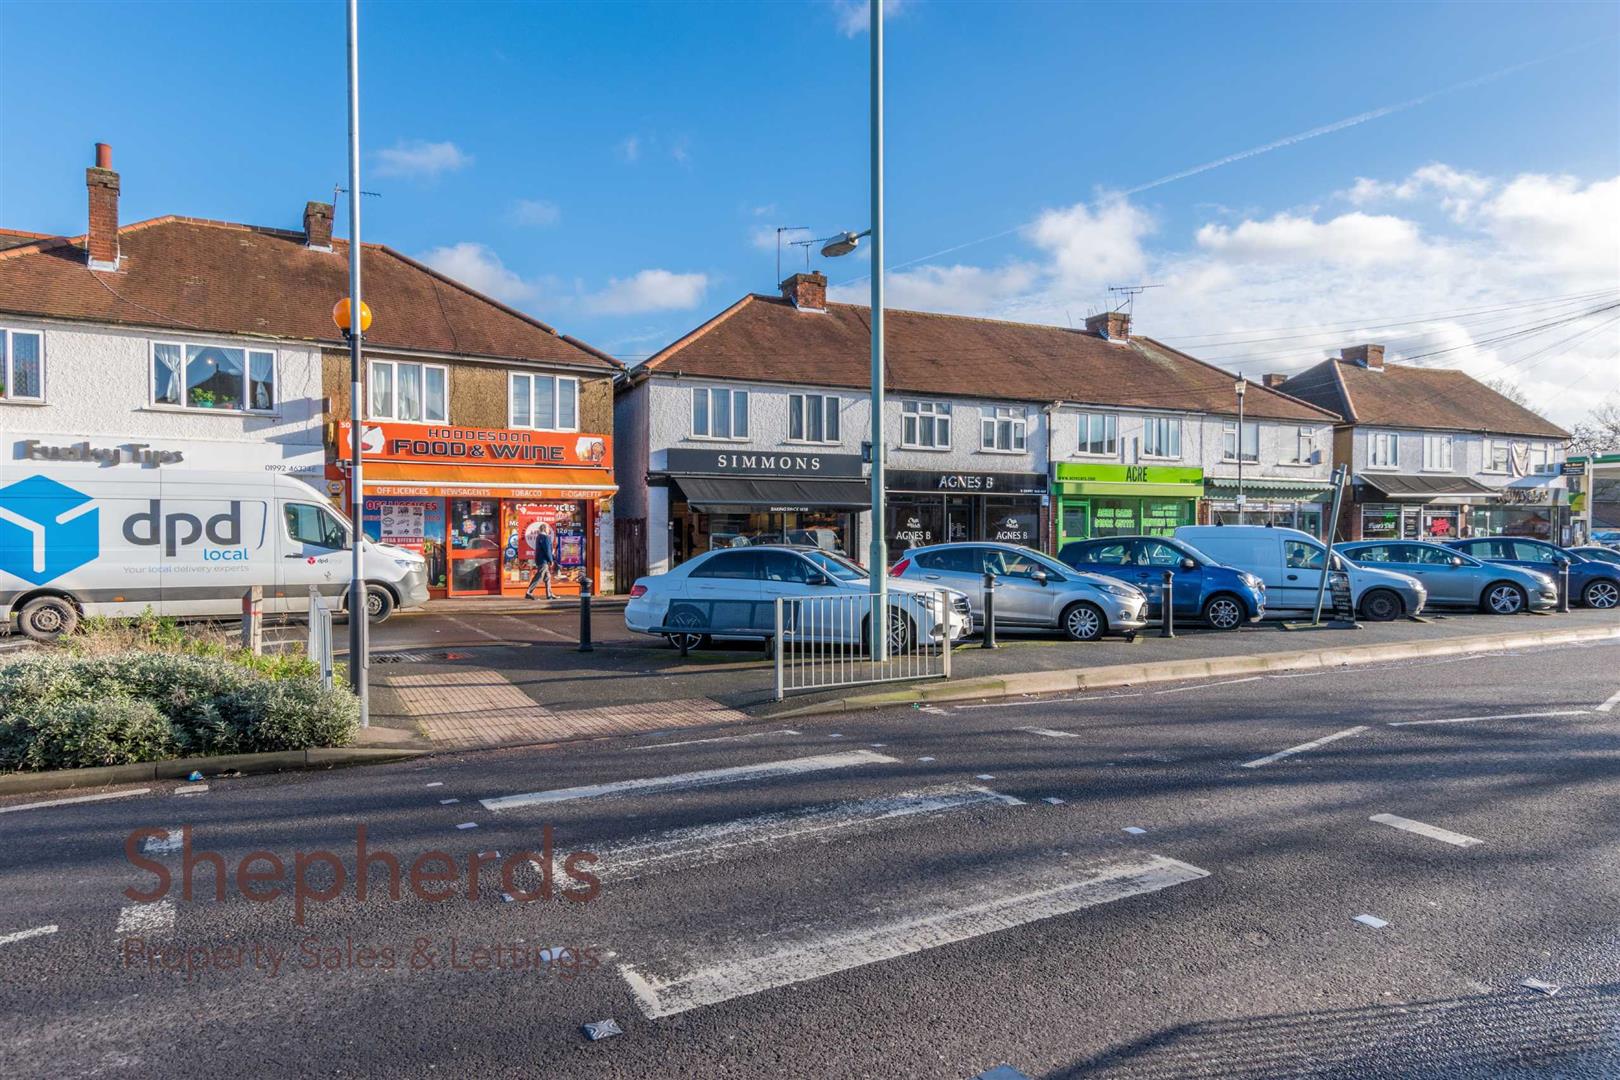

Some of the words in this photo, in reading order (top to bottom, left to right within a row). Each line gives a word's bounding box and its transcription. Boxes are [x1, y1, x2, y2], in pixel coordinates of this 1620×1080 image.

[428, 429, 531, 443] HODDESDON
[392, 439, 467, 457] FOOD
[470, 444, 485, 458] &
[489, 443, 566, 461] WINE
[264, 464, 287, 472] 01992
[717, 454, 821, 470] SIMMONS
[1126, 466, 1148, 482] ACRE
[938, 475, 981, 489] AGNES
[985, 477, 994, 489] B
[376, 487, 393, 495] OFF
[394, 487, 429, 495] LICENCES
[440, 488, 491, 496] NEWSAGENTS
[511, 489, 543, 497] TOBACCO
[121, 499, 241, 557] dpd
[896, 531, 923, 540] AGNES
[925, 531, 931, 540] B
[996, 531, 1020, 540] AGNES
[1022, 531, 1028, 540] B
[203, 548, 249, 561] local
[123, 566, 147, 574] Your
[148, 565, 172, 573] local
[173, 565, 211, 575] delivery
[213, 564, 250, 574] experts
